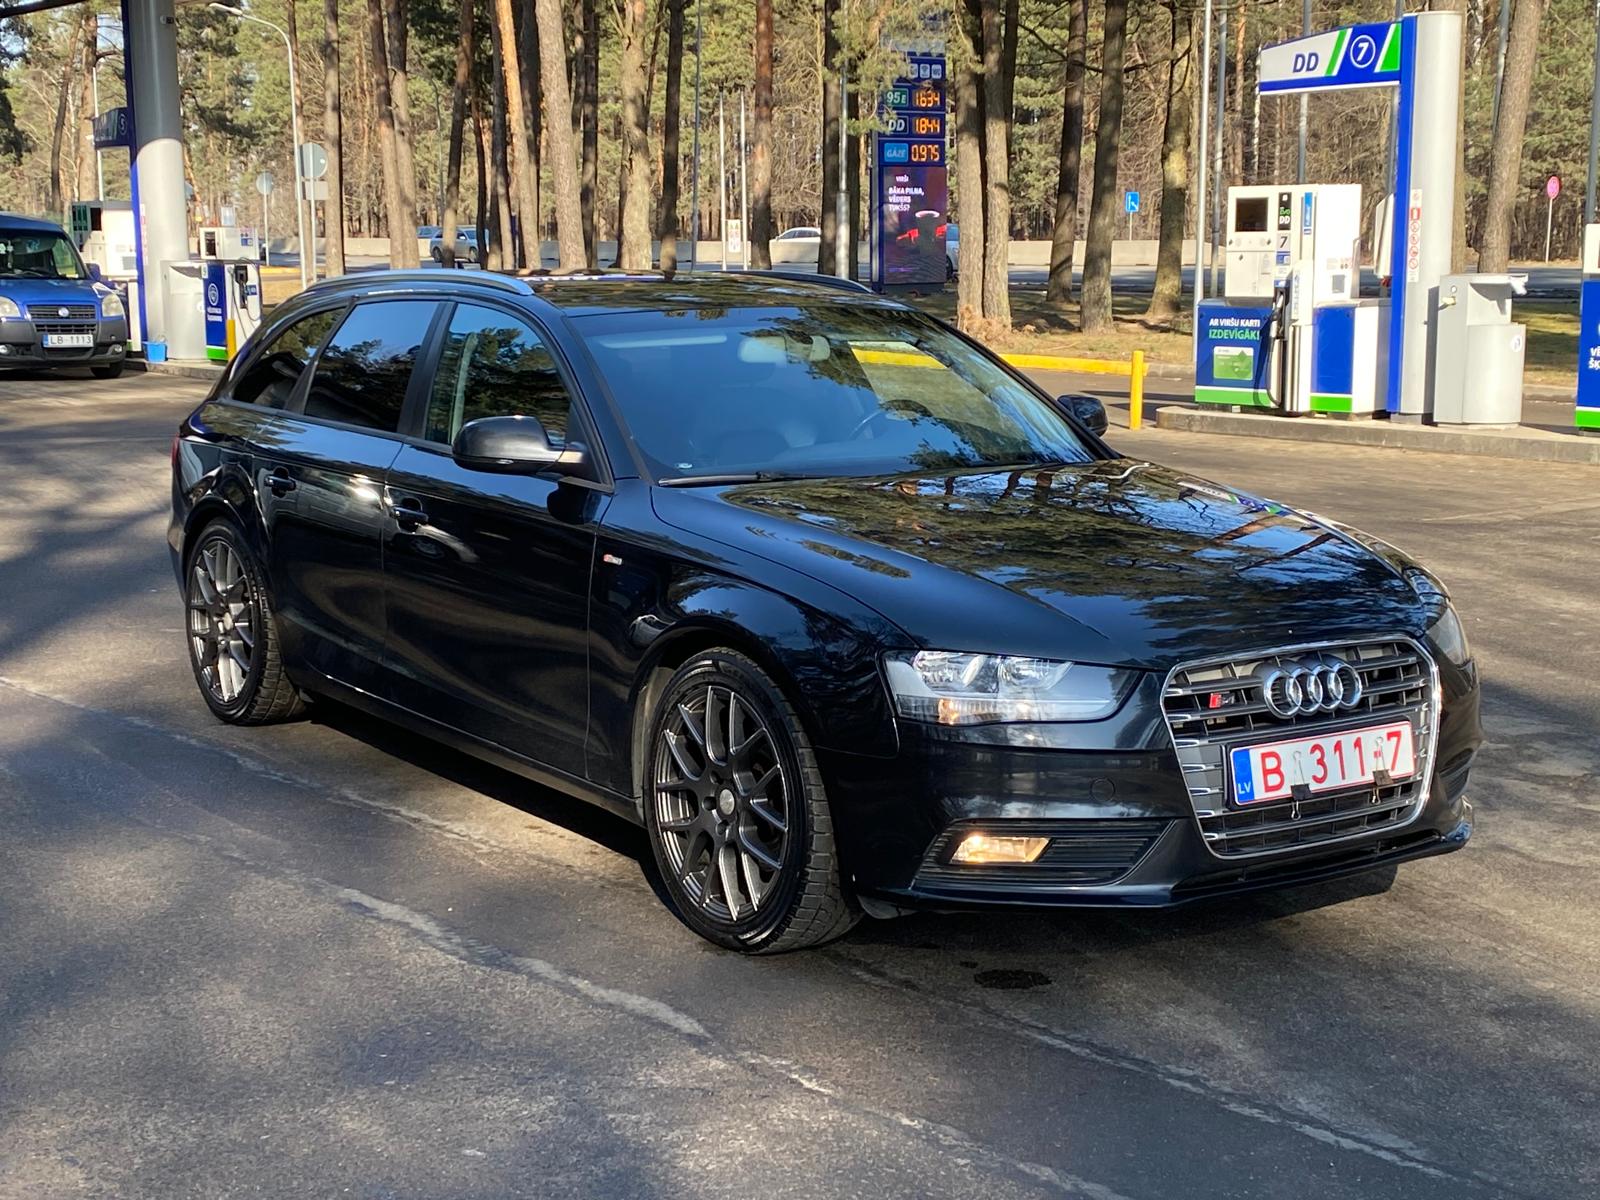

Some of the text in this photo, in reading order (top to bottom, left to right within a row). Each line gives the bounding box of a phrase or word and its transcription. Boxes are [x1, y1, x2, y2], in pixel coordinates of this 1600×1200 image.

[1356, 42, 1369, 61] 7
[1293, 53, 1319, 73] DD
[888, 119, 905, 132] DD
[1279, 215, 1291, 225] DD
[1280, 235, 1288, 249] 7
[1209, 318, 1219, 326] AR
[1260, 750, 1285, 793] B
[1237, 781, 1252, 794] LV
